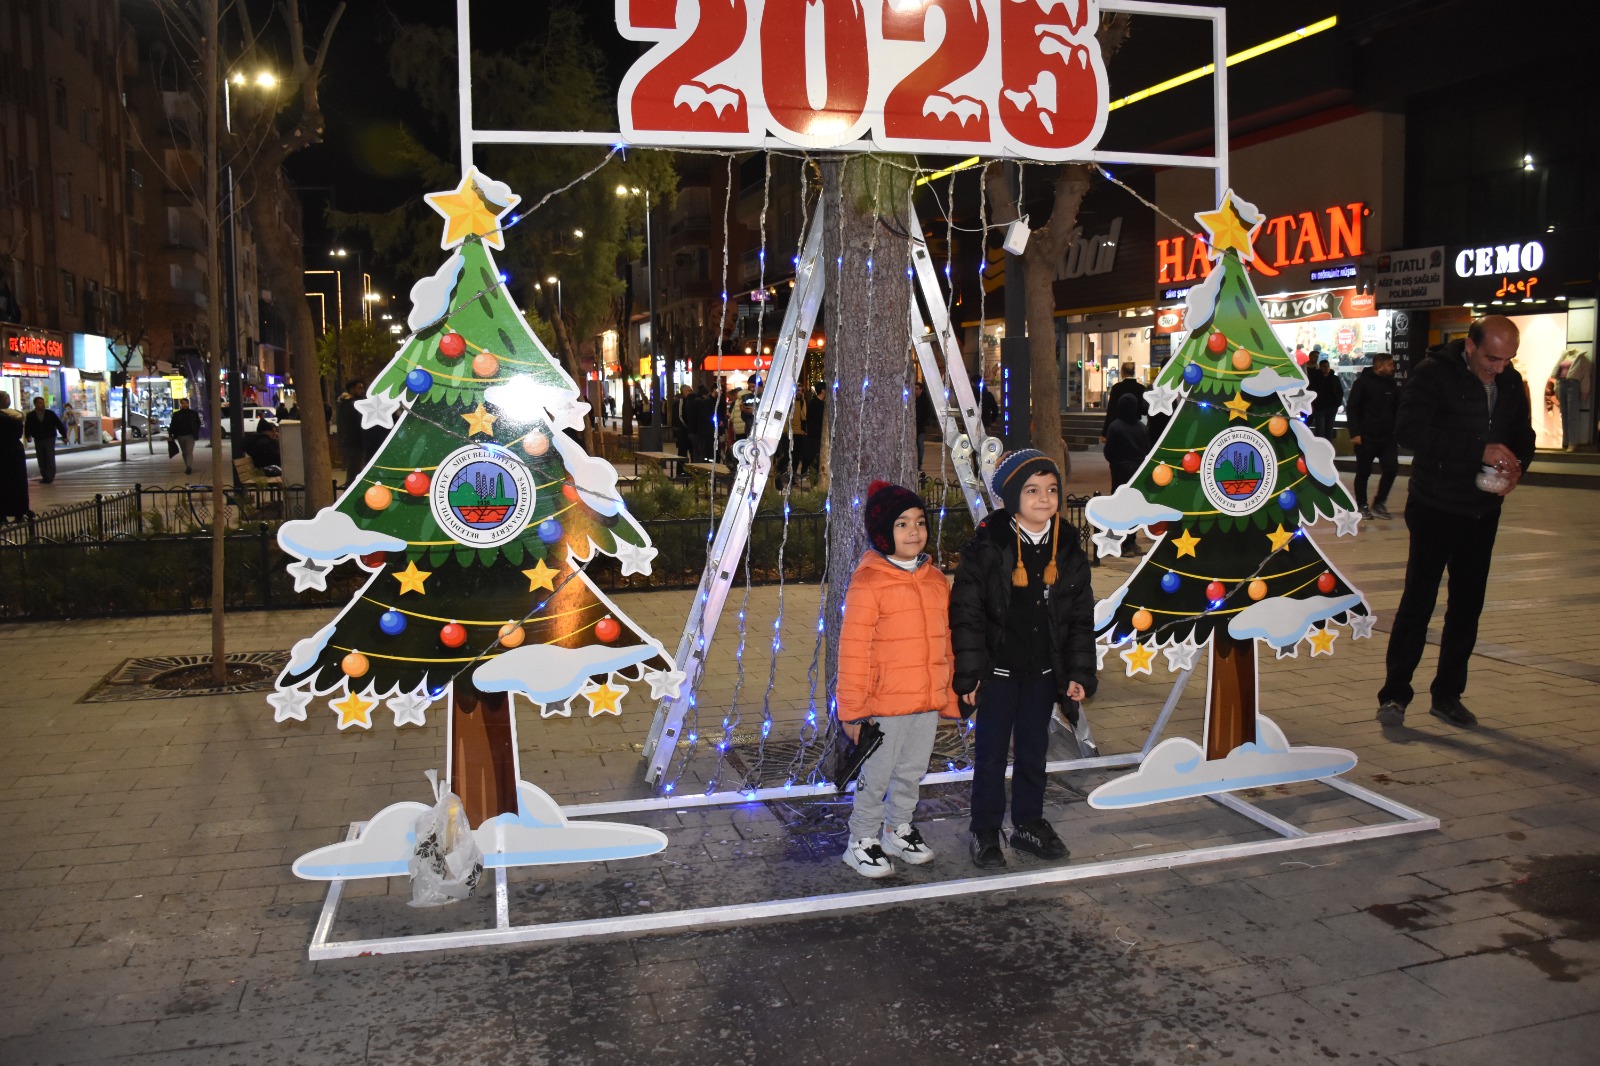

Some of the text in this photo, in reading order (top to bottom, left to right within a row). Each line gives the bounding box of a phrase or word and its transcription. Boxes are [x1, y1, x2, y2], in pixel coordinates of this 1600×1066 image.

[627, 0, 1099, 149] 2025
[1397, 258, 1426, 273] TATLI
[1455, 241, 1544, 278] CEMO
[1495, 276, 1539, 298] deep
[1291, 294, 1329, 316] YOK
